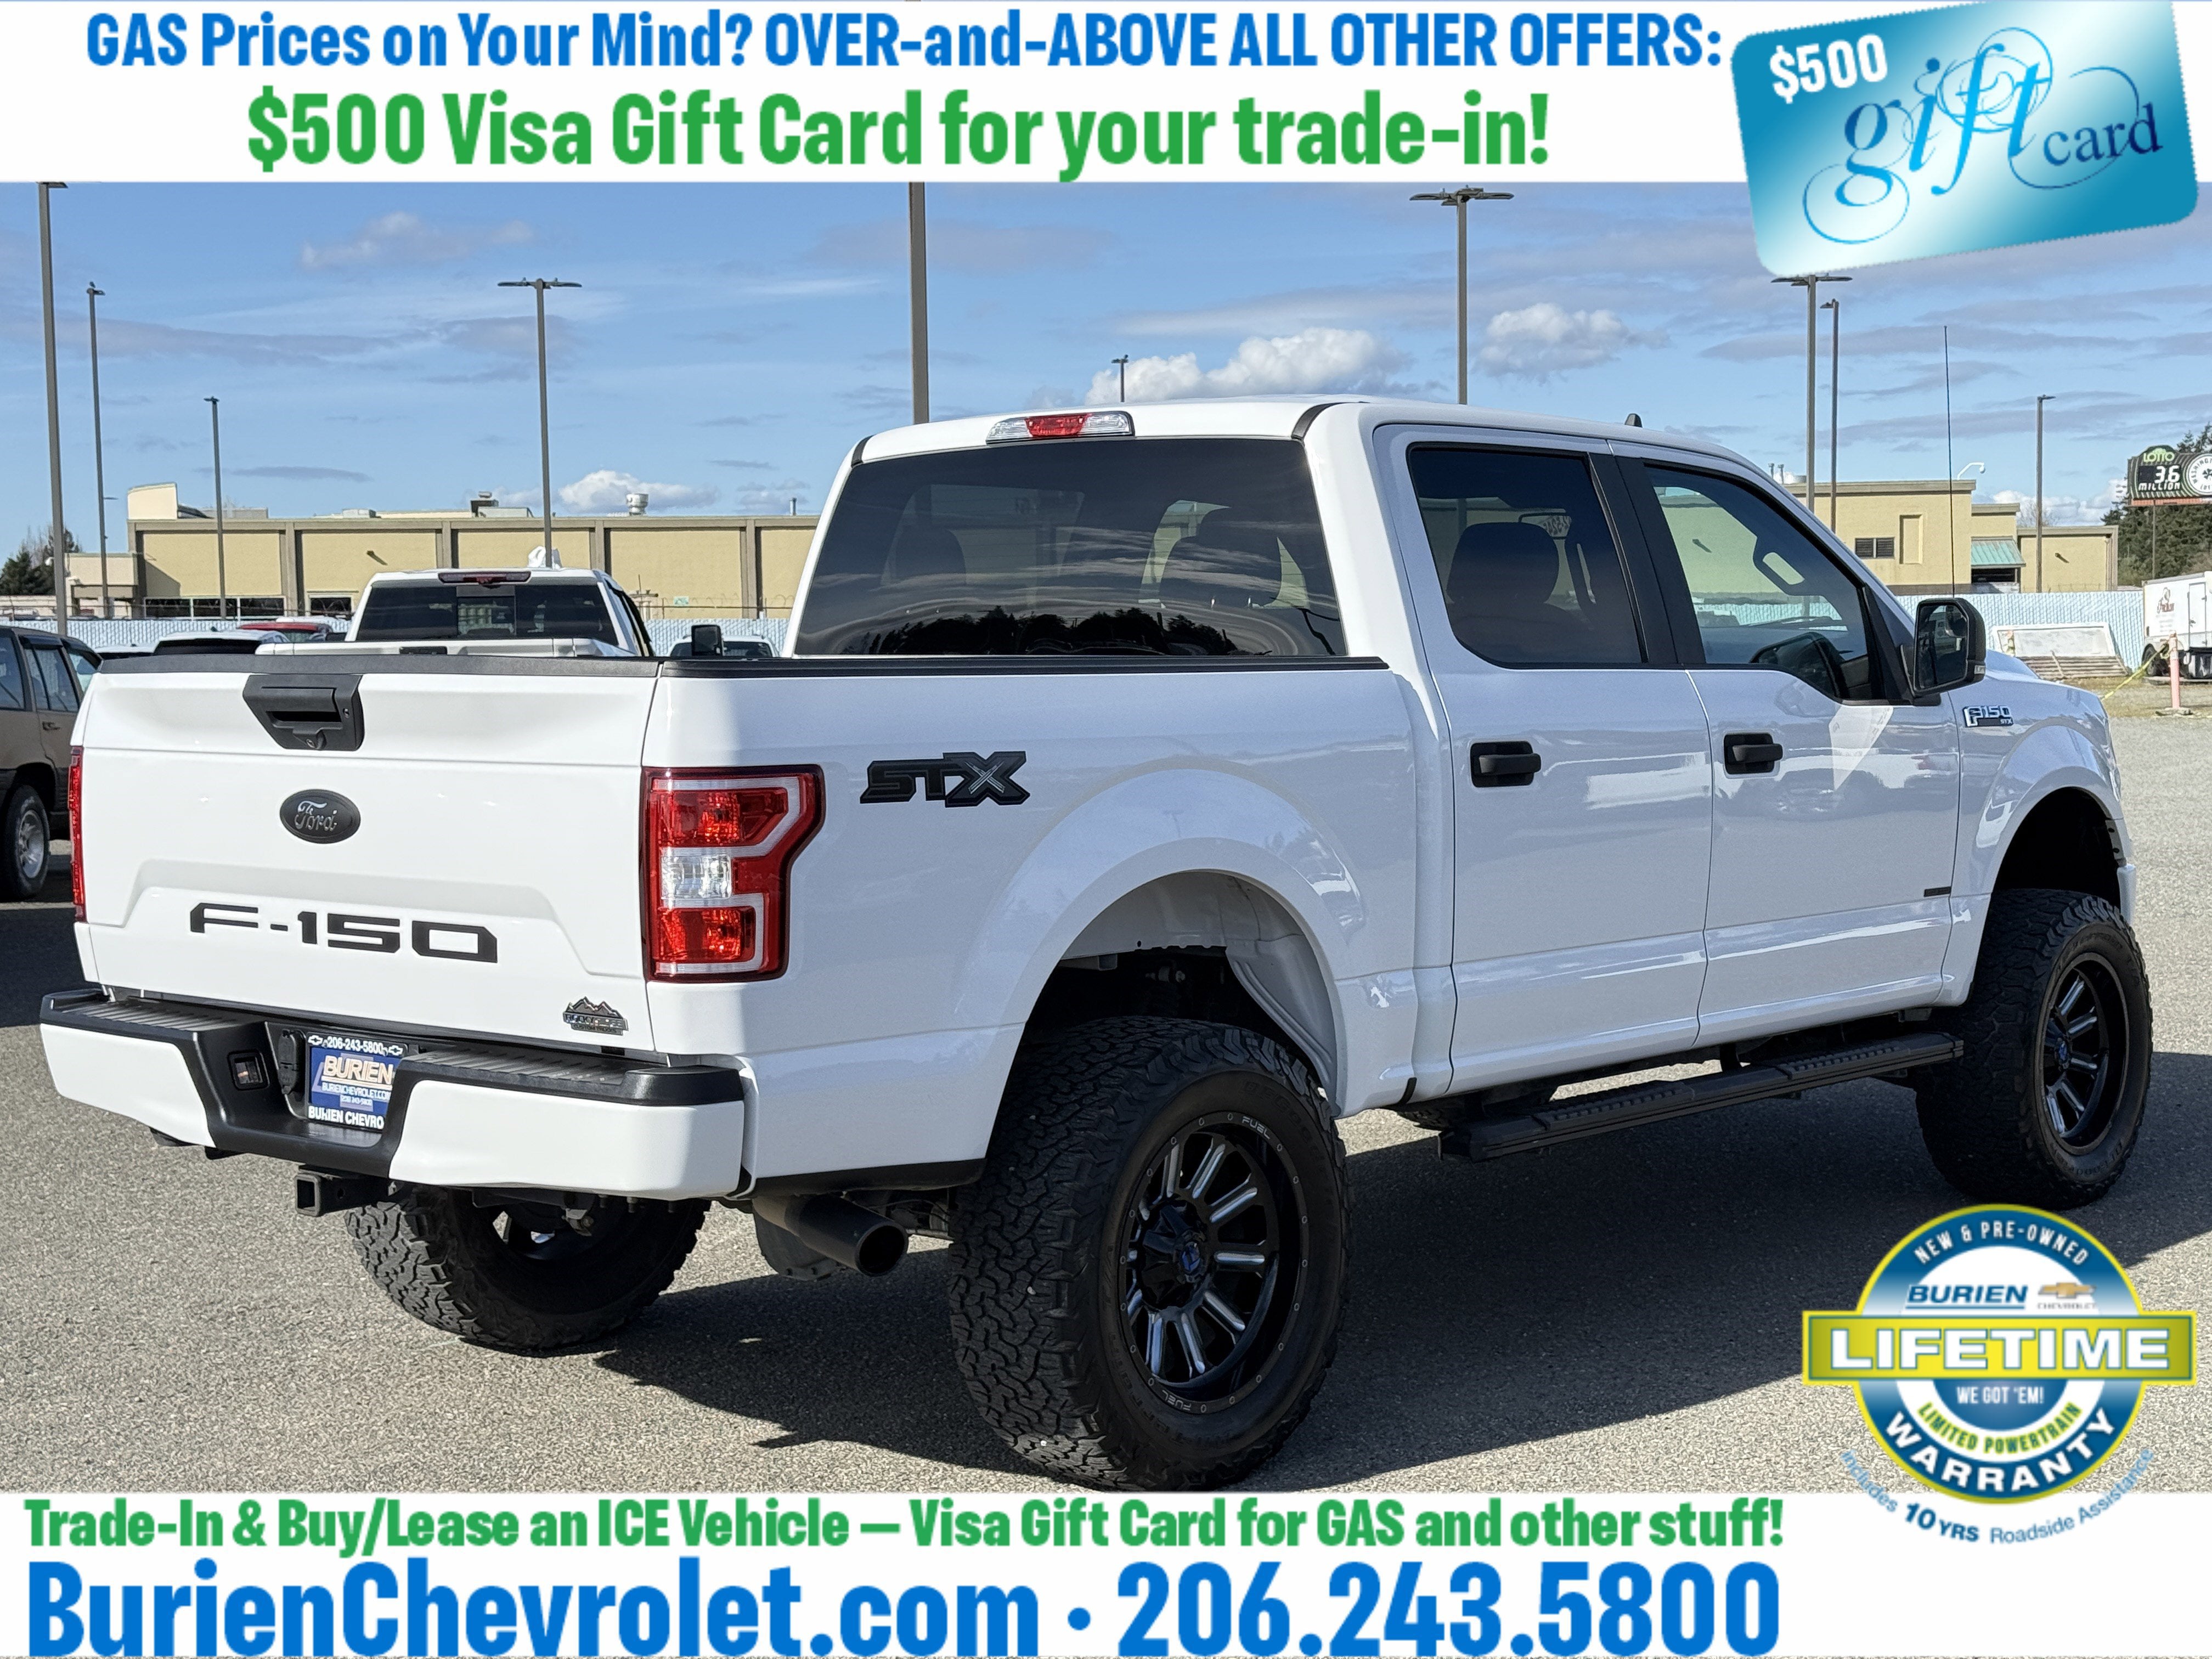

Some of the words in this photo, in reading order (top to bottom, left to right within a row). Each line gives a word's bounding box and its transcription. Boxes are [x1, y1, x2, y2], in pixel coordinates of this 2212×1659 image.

[2143, 449, 2175, 462] LOTTO
[2138, 482, 2181, 491] MILLION
[860, 751, 1030, 808] STX
[294, 800, 338, 833] Ford
[190, 902, 498, 964] F-150
[327, 1036, 383, 1055] 206-243-5800
[323, 1055, 394, 1085] BURIEN
[1242, 1115, 1271, 1140] FUEL
